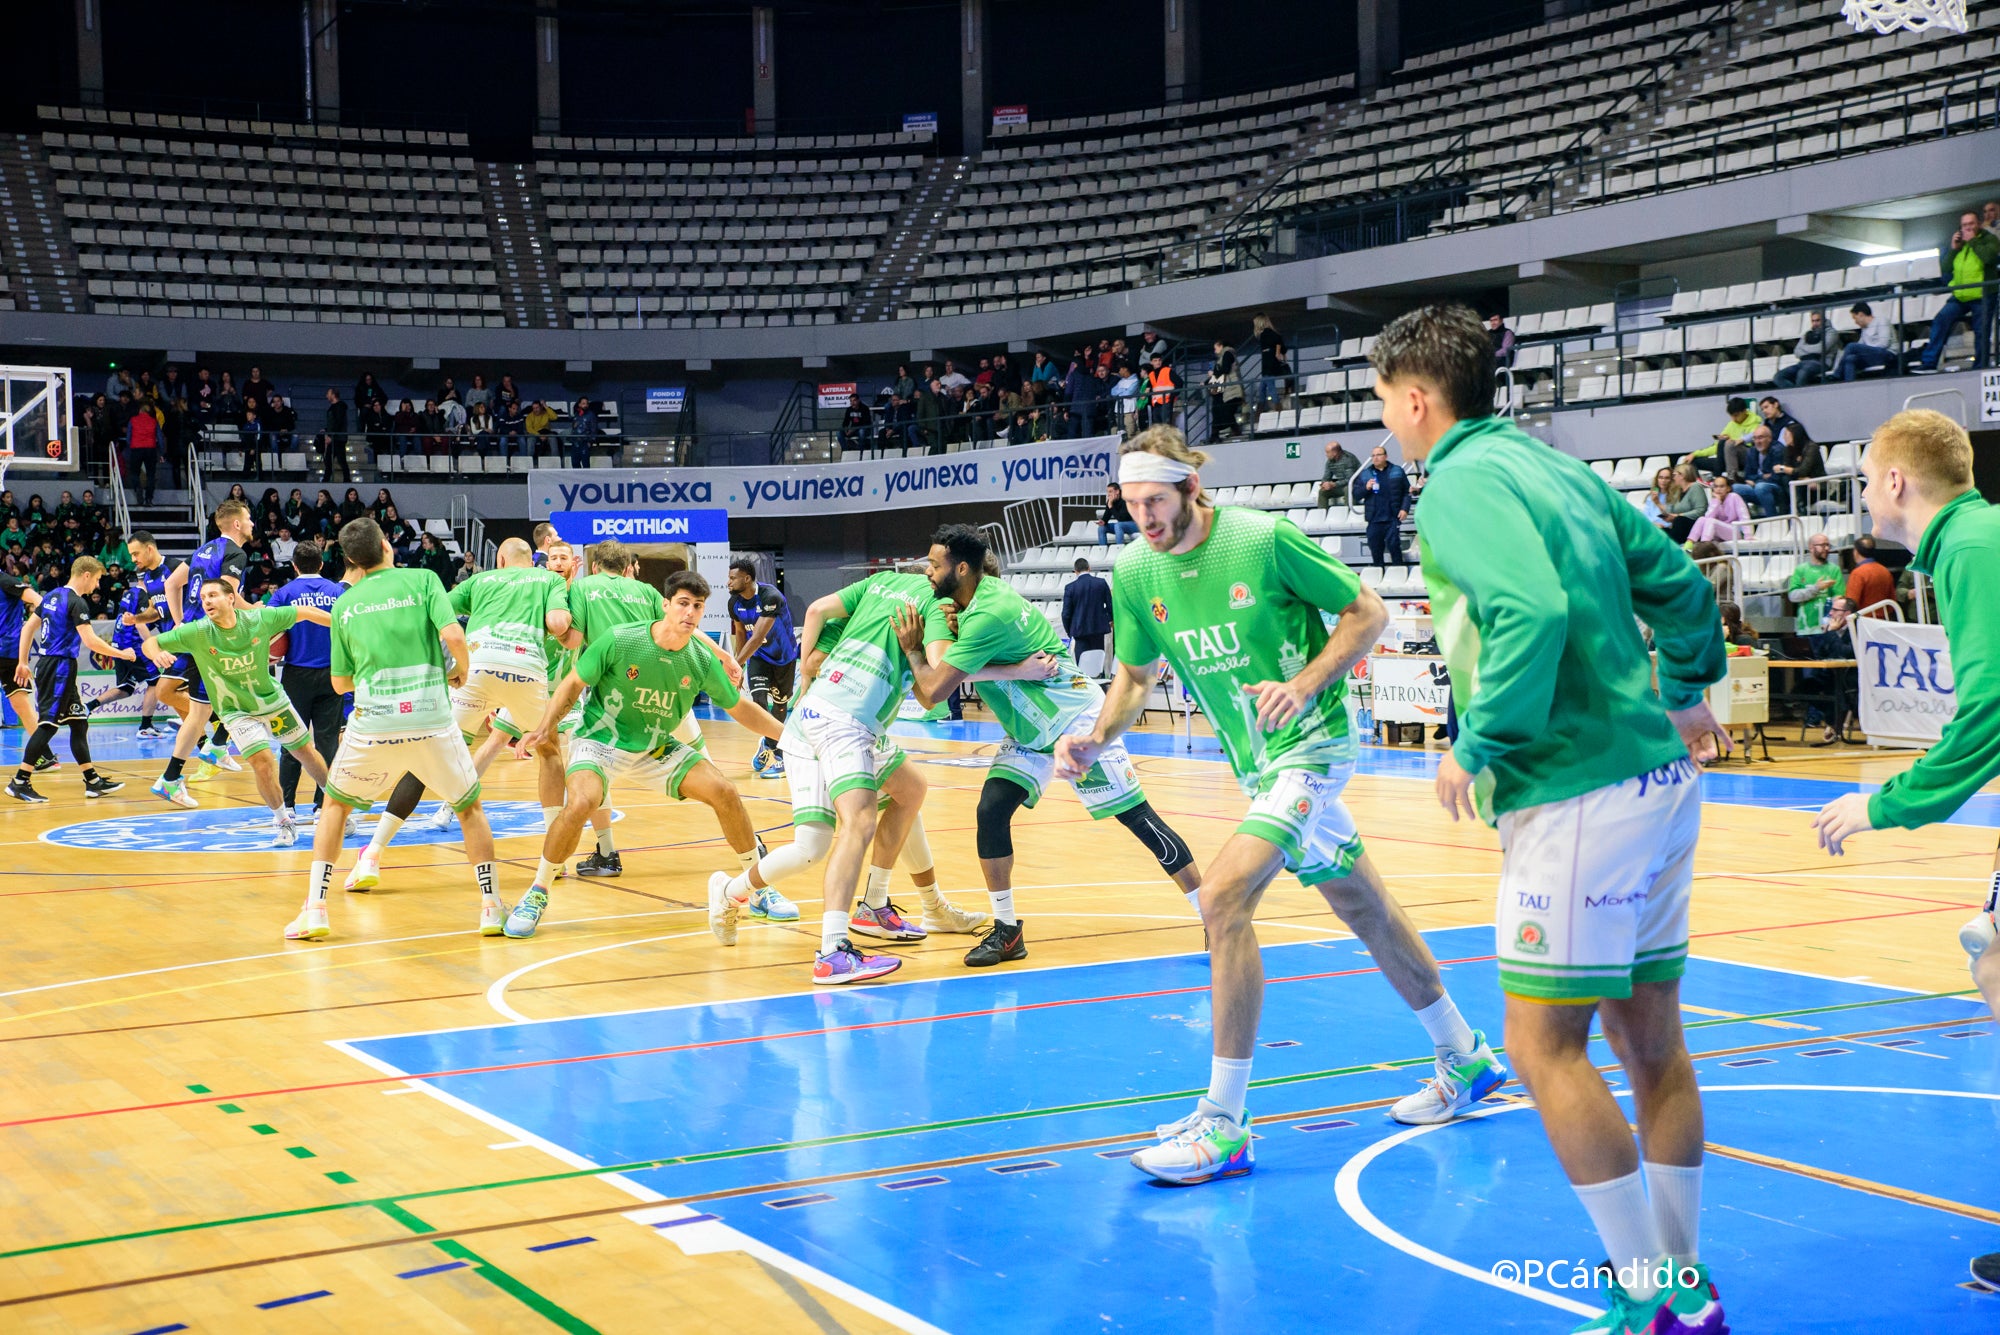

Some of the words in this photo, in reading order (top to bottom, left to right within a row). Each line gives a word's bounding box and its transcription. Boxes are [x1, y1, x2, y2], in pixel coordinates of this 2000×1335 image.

[1985, 391, 2000, 402] PA
[559, 481, 712, 511] younexa
[743, 475, 864, 509] younexa
[884, 462, 978, 502] younexa
[1002, 452, 1111, 491] younexa
[593, 517, 689, 535] DECATHLON
[353, 594, 416, 615] CaixaBank
[1174, 622, 1241, 661] TAU
[219, 651, 255, 671] TAU
[1865, 641, 1955, 694] TAU
[634, 687, 678, 710] TAU
[1374, 685, 1445, 704] PATRONAT
[1303, 773, 1325, 794] TAU
[1517, 891, 1551, 911] TAU
